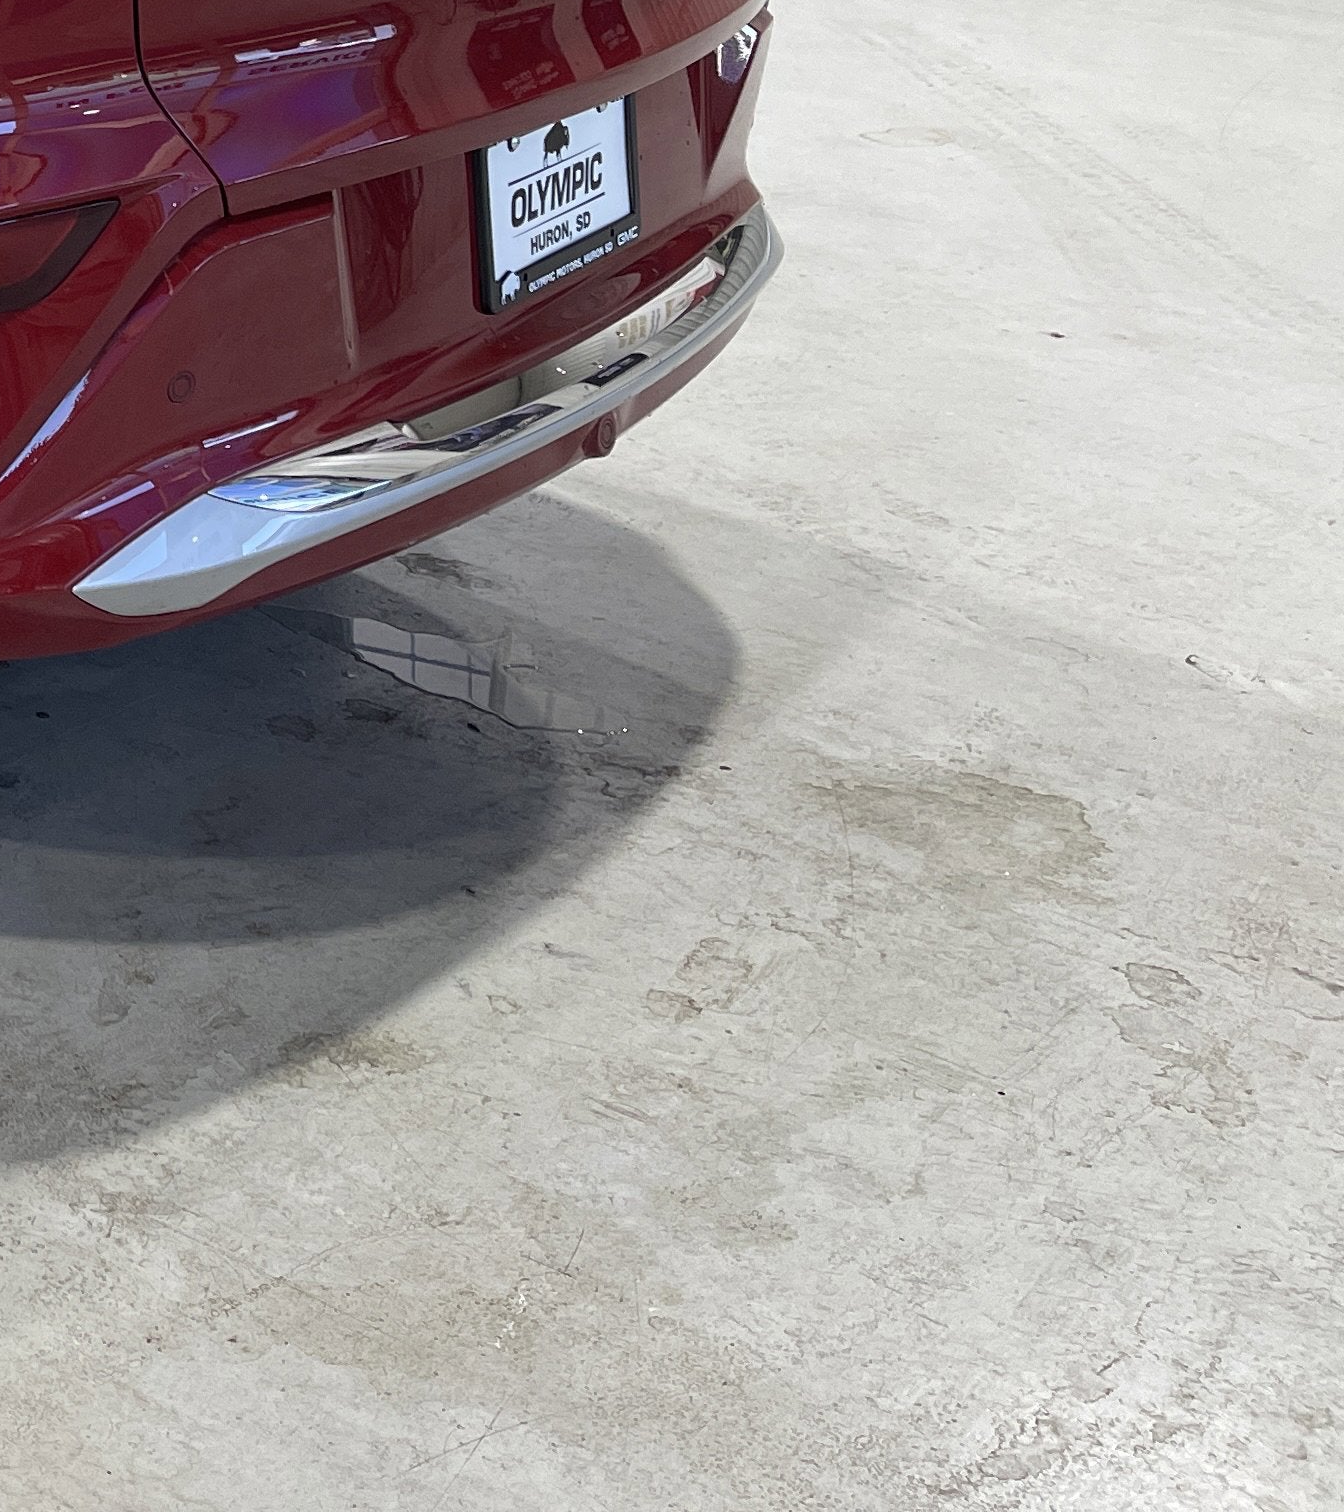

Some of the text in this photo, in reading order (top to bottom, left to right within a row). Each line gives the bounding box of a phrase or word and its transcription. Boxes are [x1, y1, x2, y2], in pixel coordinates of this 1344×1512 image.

[510, 151, 603, 228] OLYMPIC
[530, 210, 591, 256] HURON, SD
[616, 225, 639, 246] GMC
